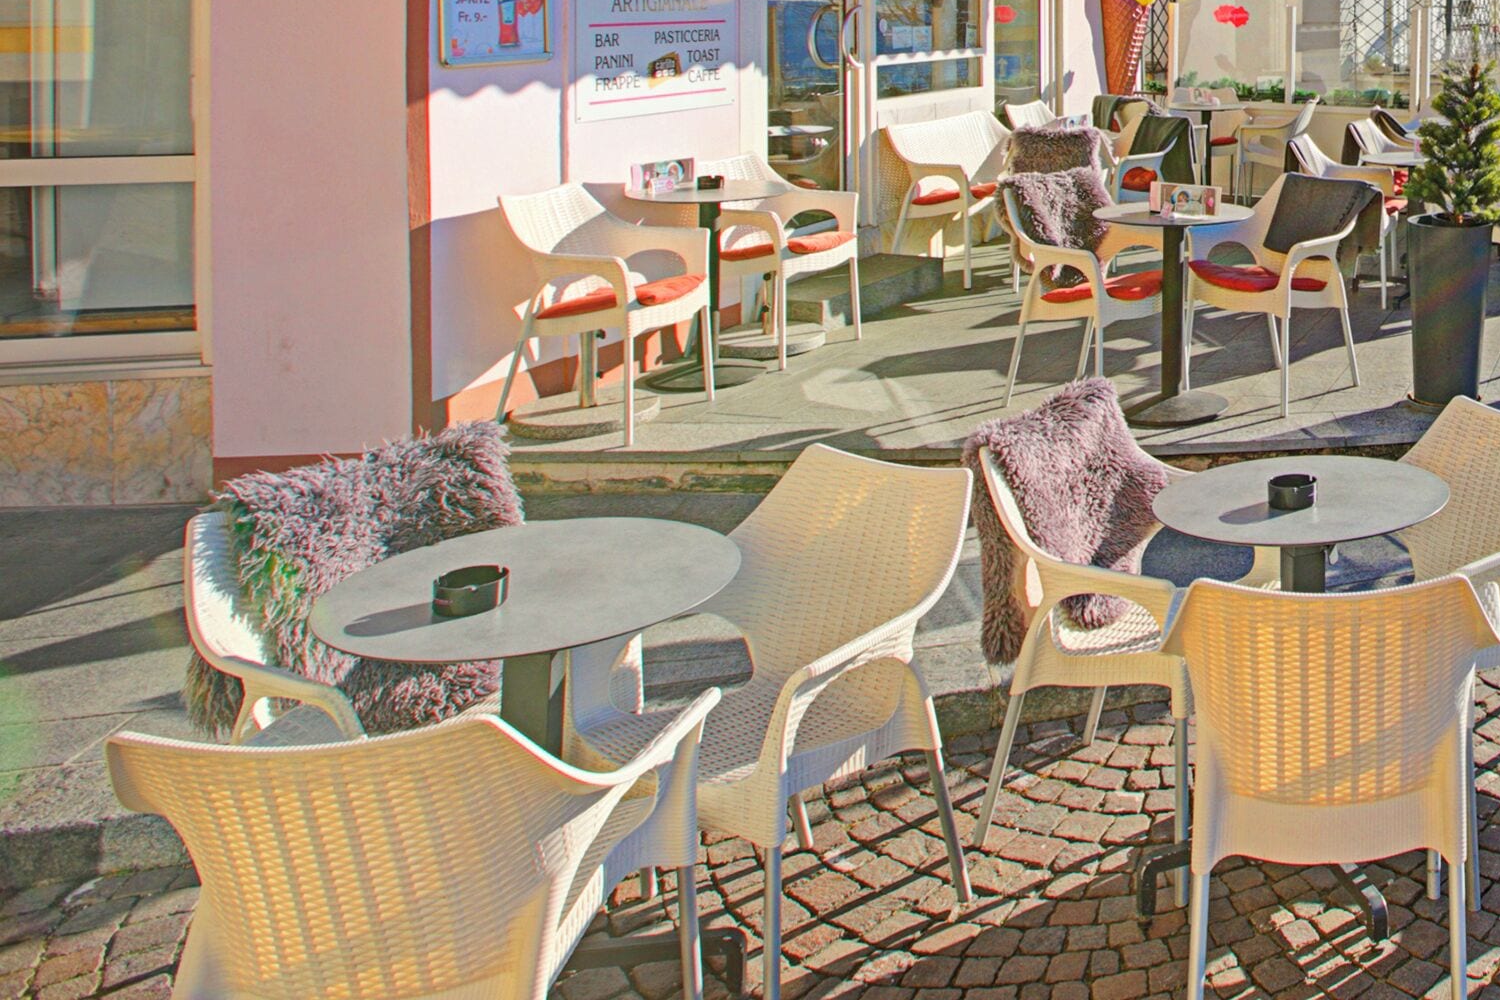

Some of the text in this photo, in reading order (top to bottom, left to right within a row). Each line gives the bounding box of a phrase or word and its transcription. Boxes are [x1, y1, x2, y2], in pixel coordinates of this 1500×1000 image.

[458, 11, 472, 22] Fr.
[595, 33, 620, 48] BAR
[654, 29, 721, 45] PASTICCERIA
[595, 54, 634, 70] PANINI
[687, 48, 720, 63] TOAST
